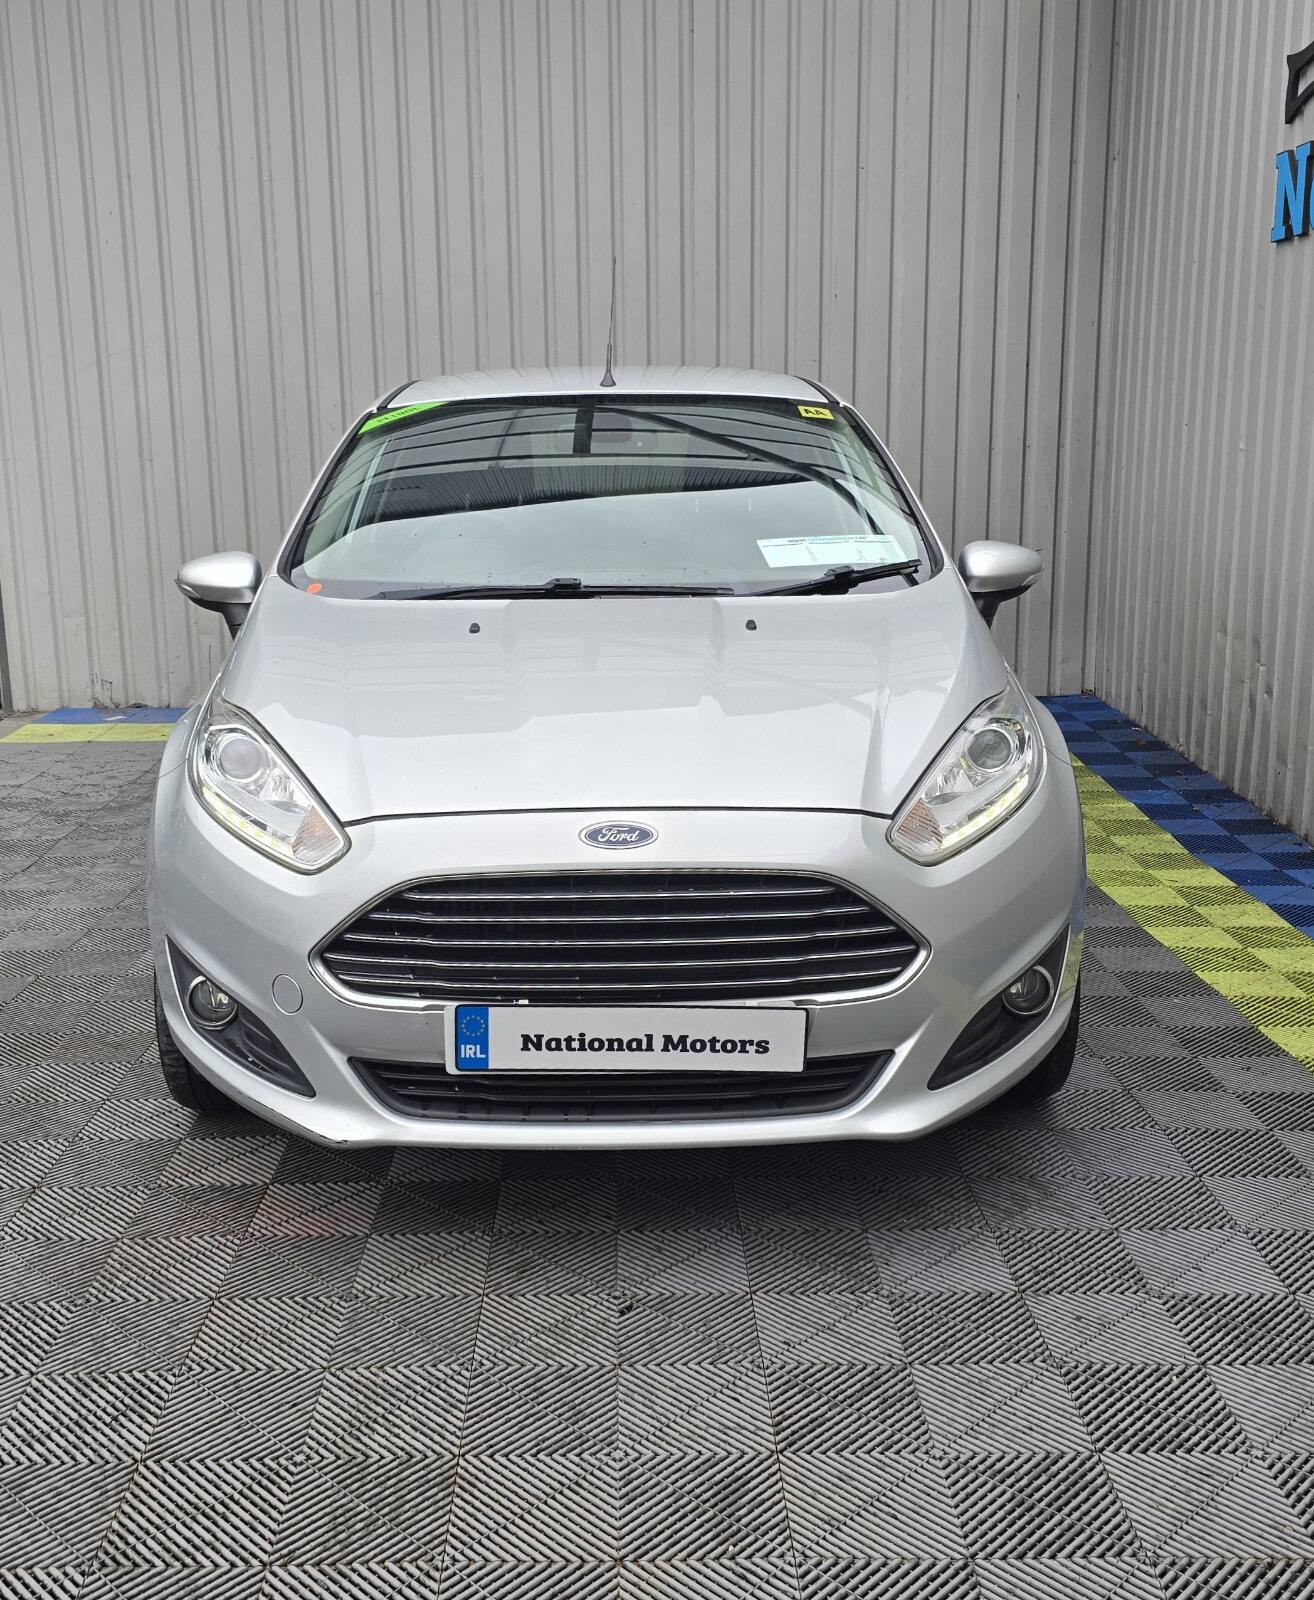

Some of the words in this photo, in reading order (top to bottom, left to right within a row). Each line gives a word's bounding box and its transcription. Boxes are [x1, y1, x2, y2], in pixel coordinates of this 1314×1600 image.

[597, 827, 640, 842] Ford
[460, 1043, 487, 1059] IRL
[520, 1032, 656, 1053] National
[660, 1034, 770, 1054] Motors
